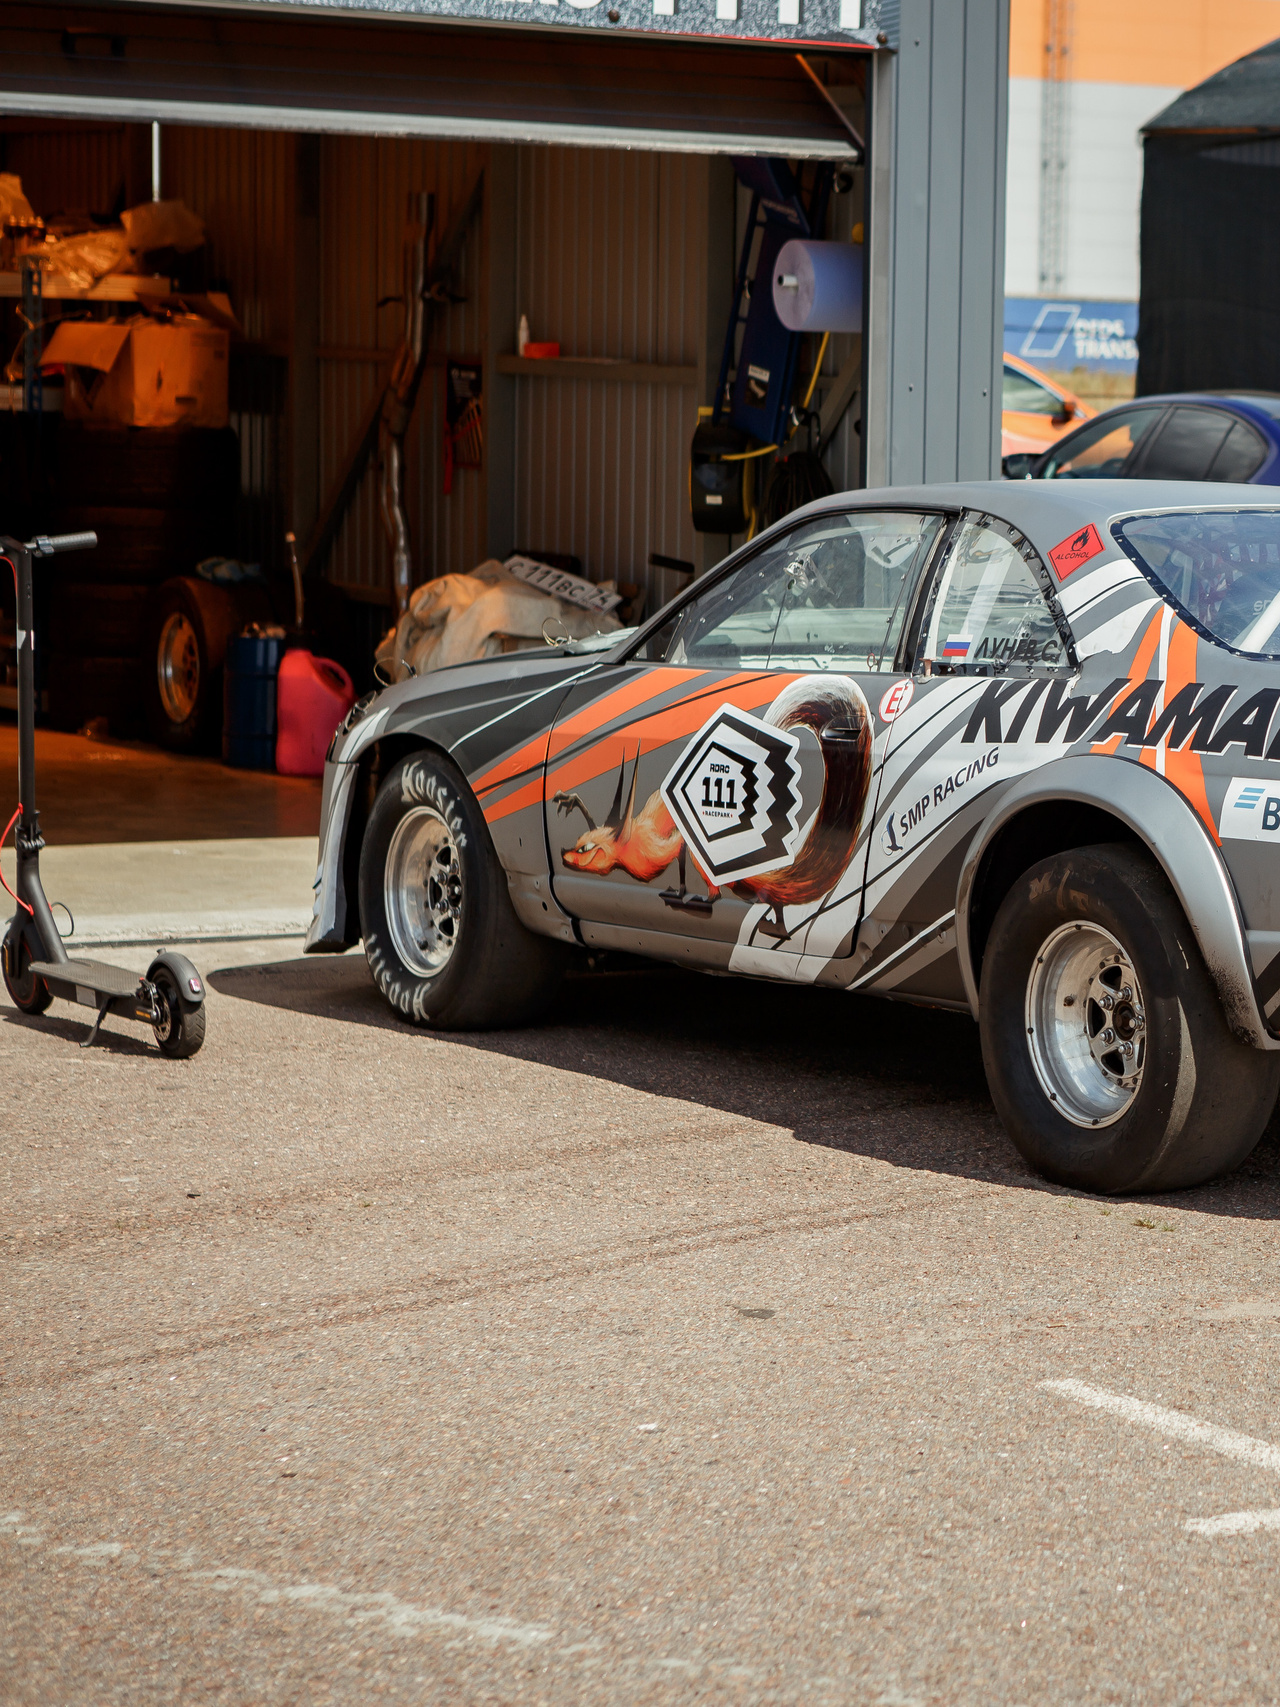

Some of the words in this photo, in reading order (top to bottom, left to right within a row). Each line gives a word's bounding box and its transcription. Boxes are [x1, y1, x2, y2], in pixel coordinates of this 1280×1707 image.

[1055, 551, 1089, 561] ALCOHOL
[885, 685, 909, 714] E
[702, 776, 738, 810] 111
[900, 795, 930, 837] SMP
[933, 746, 999, 807] RACING
